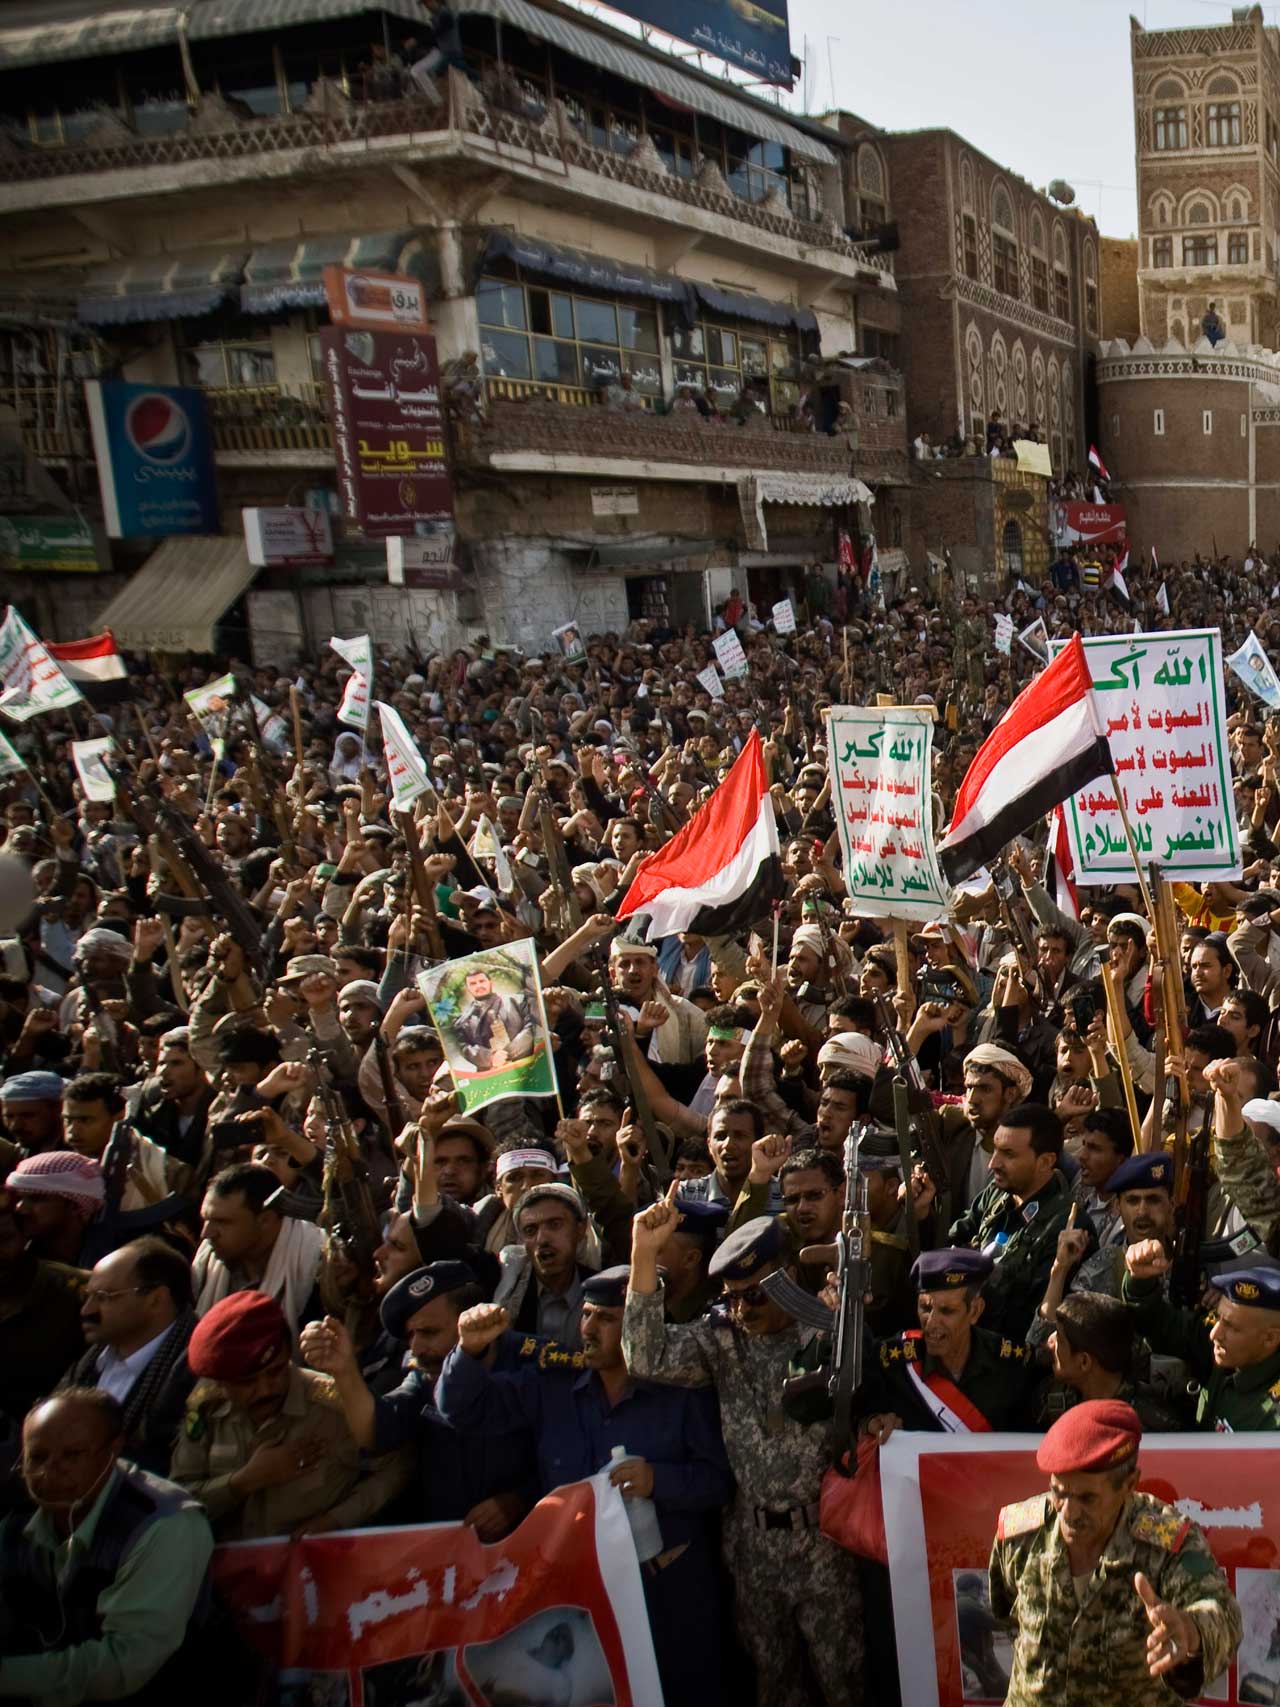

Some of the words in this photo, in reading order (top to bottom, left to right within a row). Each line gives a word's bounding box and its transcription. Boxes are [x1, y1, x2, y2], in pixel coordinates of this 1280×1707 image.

[358, 440, 445, 460] سويد
[1094, 645, 1147, 690] أك
[1154, 646, 1207, 686] الله
[1106, 699, 1141, 737] لأمر
[1148, 702, 1210, 734] الموت
[839, 725, 886, 766] أكبر
[889, 732, 922, 762] الله
[1152, 743, 1214, 774] الموت
[1114, 745, 1146, 777] لإسر
[887, 775, 920, 798] الموت
[1079, 787, 1128, 816] ايهود
[1136, 786, 1164, 814] على
[1172, 782, 1219, 807] اللعنة
[887, 808, 920, 831] الموت
[900, 836, 925, 860] اللعنة
[1162, 816, 1224, 860] النصر
[900, 866, 935, 895] النصر
